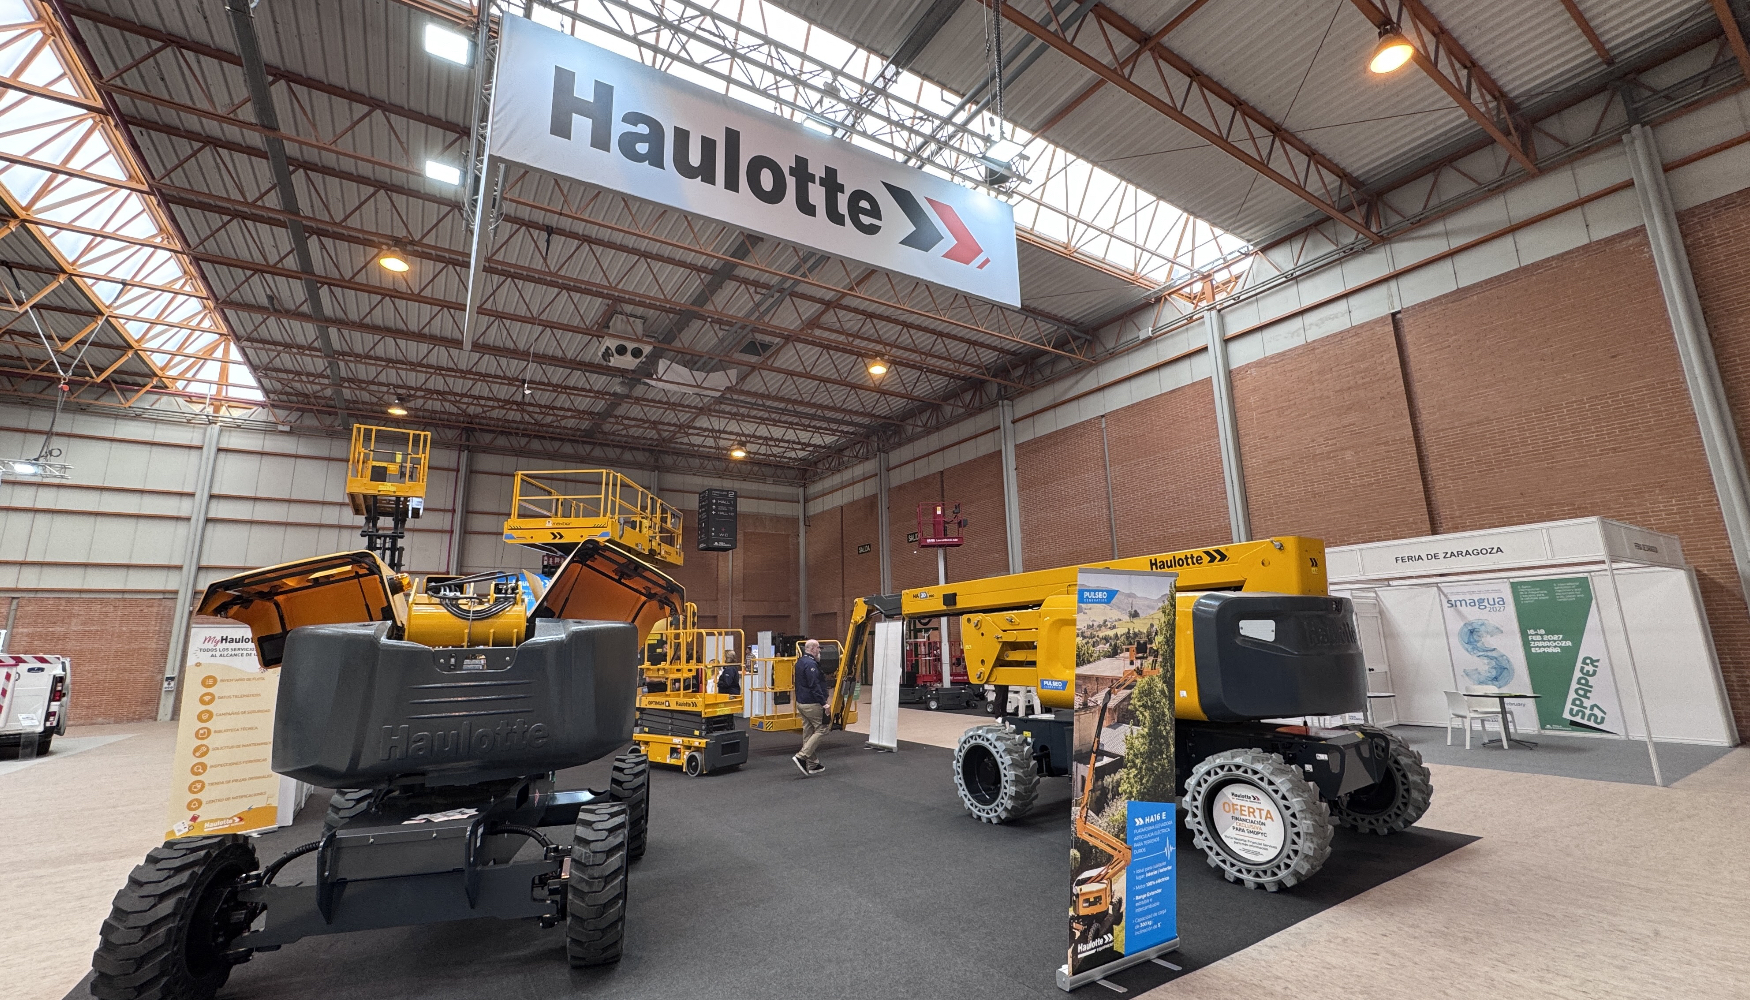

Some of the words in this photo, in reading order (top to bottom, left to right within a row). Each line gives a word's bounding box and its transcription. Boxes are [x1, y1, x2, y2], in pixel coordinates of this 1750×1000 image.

[550, 65, 882, 235] Haulotte
[1395, 554, 1424, 563] FERIA
[1426, 552, 1440, 561] DE
[1443, 546, 1504, 559] ZARAGOZA
[1149, 553, 1203, 571] Haulotte
[1083, 591, 1108, 599] PULSEO
[1446, 596, 1505, 610] smagua
[1568, 655, 1601, 721] SPAPER
[1586, 703, 1607, 726] 27
[380, 718, 550, 761] Haulotte
[1231, 791, 1251, 800] Haulotte
[1144, 813, 1161, 825] HA16
[1161, 811, 1167, 820] E
[1222, 801, 1275, 822] OFERTA
[203, 818, 233, 829] Haulotte
[1231, 815, 1266, 827] FINANCIACIÓN
[1235, 821, 1263, 831] EXCLUSIVA
[1232, 825, 1246, 833] PARA
[1135, 893, 1147, 901] Range
[1146, 888, 1163, 897] Extender
[1077, 937, 1104, 953] Haulotte
